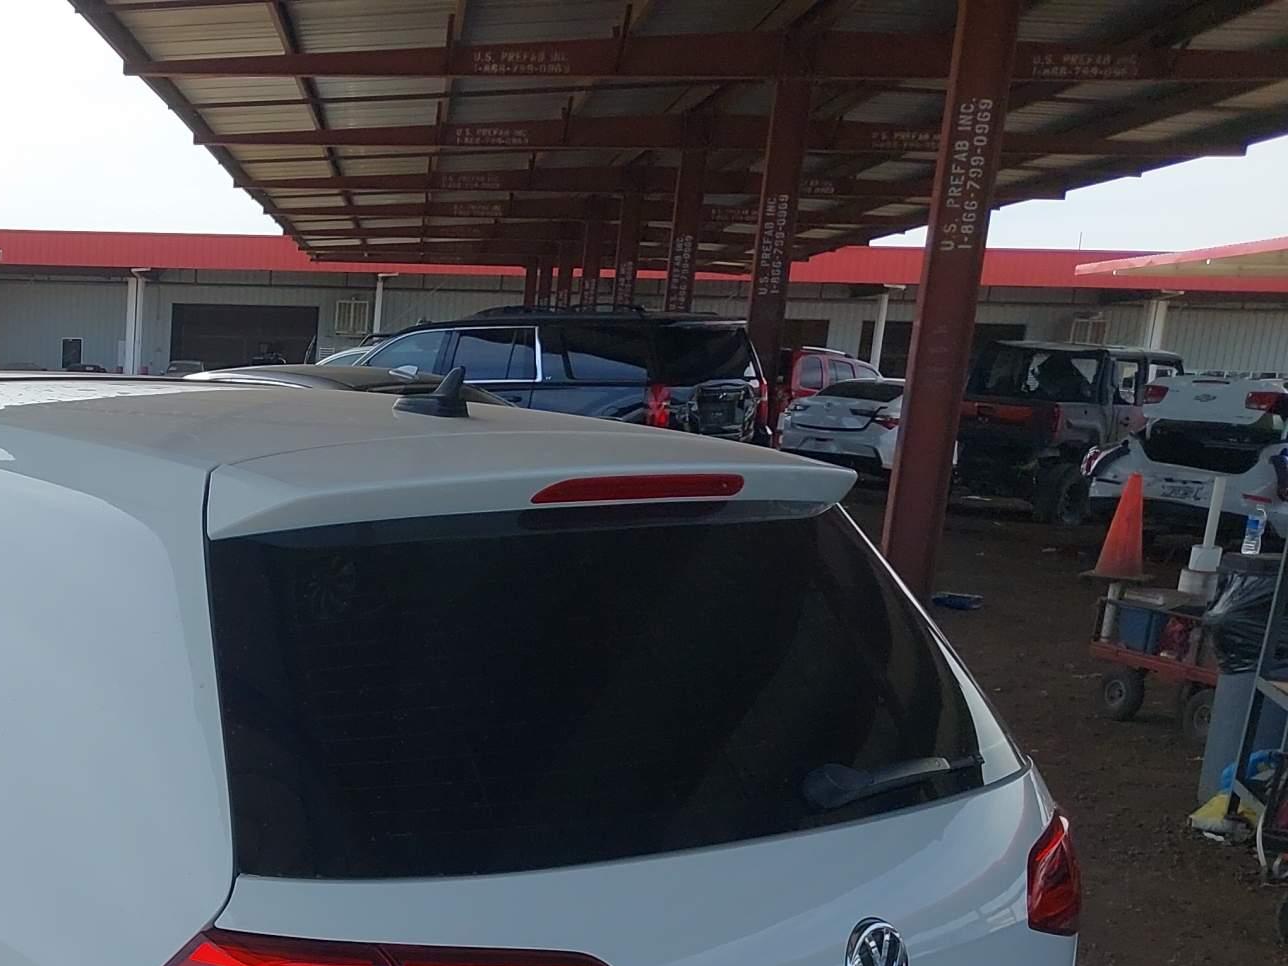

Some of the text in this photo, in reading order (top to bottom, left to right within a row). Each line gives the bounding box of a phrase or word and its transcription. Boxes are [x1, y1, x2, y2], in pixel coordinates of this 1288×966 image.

[760, 222, 775, 267] PREFAB
[940, 97, 976, 250] U.S. PREFAB INC.
[957, 98, 993, 249] 1-866-799-0969
